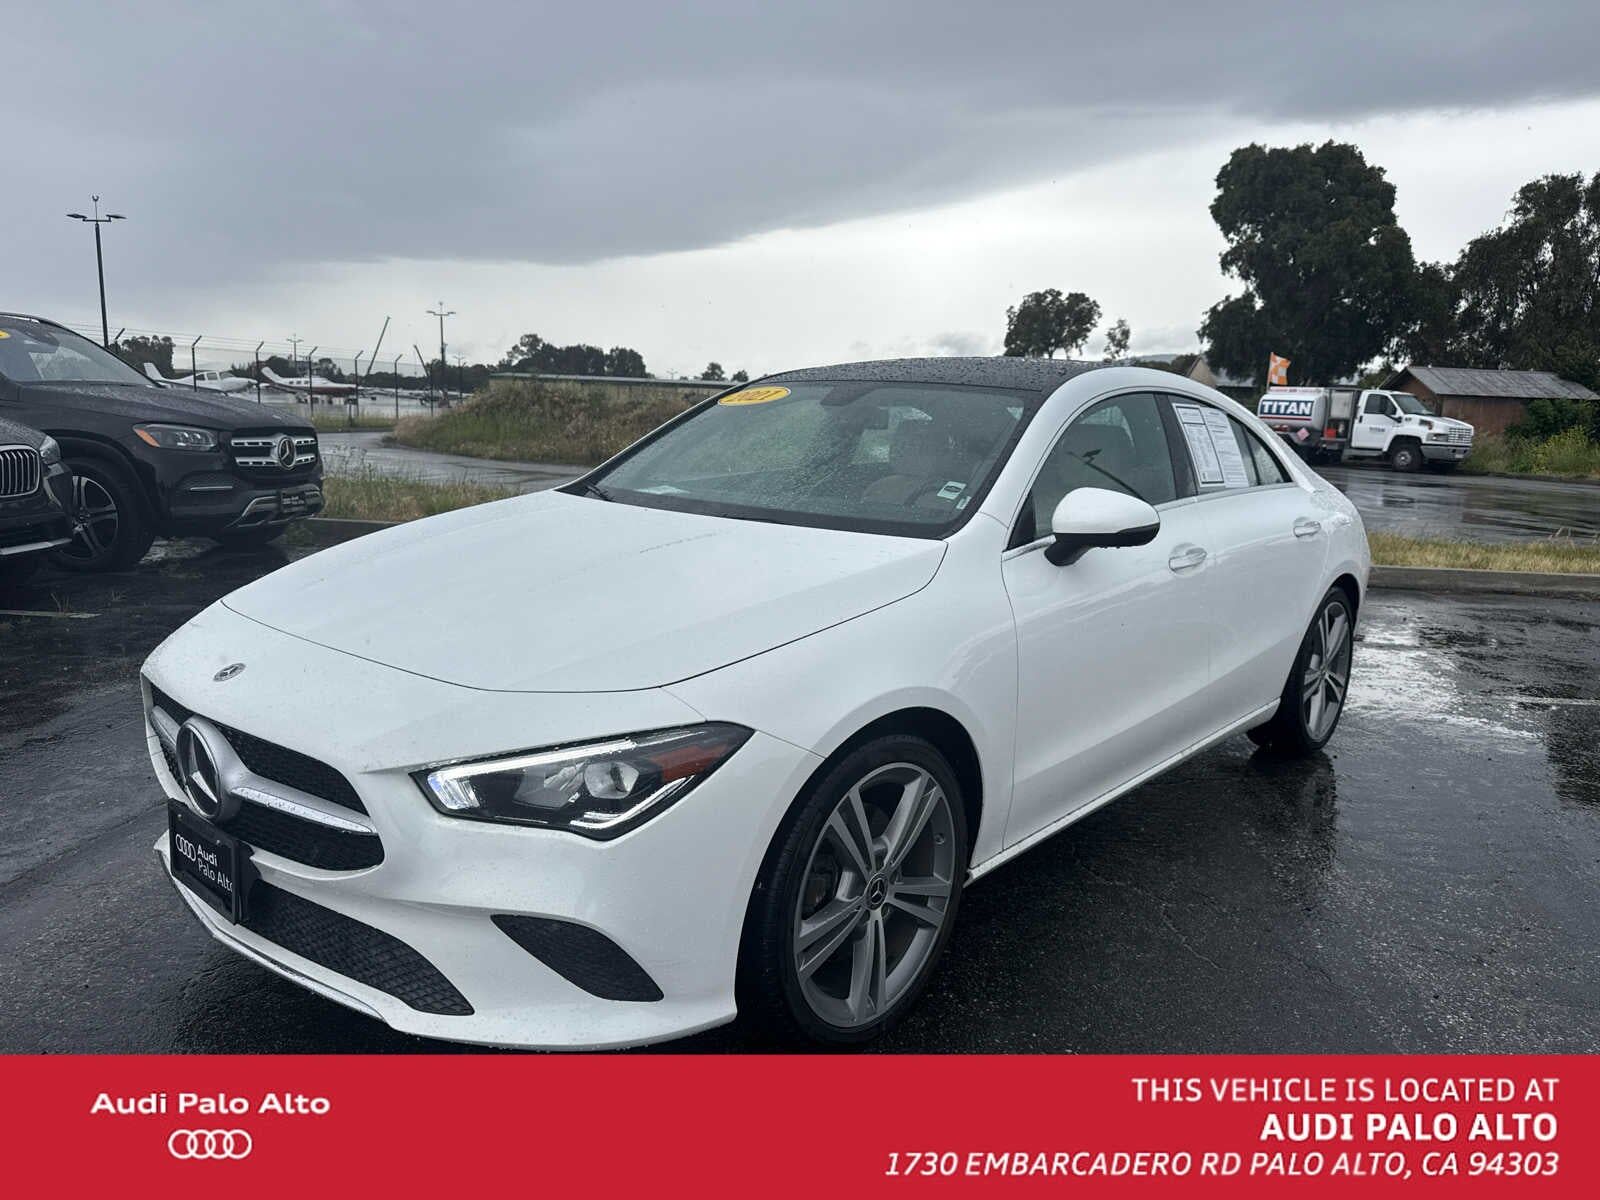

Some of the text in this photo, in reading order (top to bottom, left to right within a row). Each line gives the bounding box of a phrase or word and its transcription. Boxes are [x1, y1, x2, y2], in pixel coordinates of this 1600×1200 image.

[1262, 401, 1312, 415] TITAN
[197, 844, 218, 867] Audi
[198, 858, 216, 881] Palo
